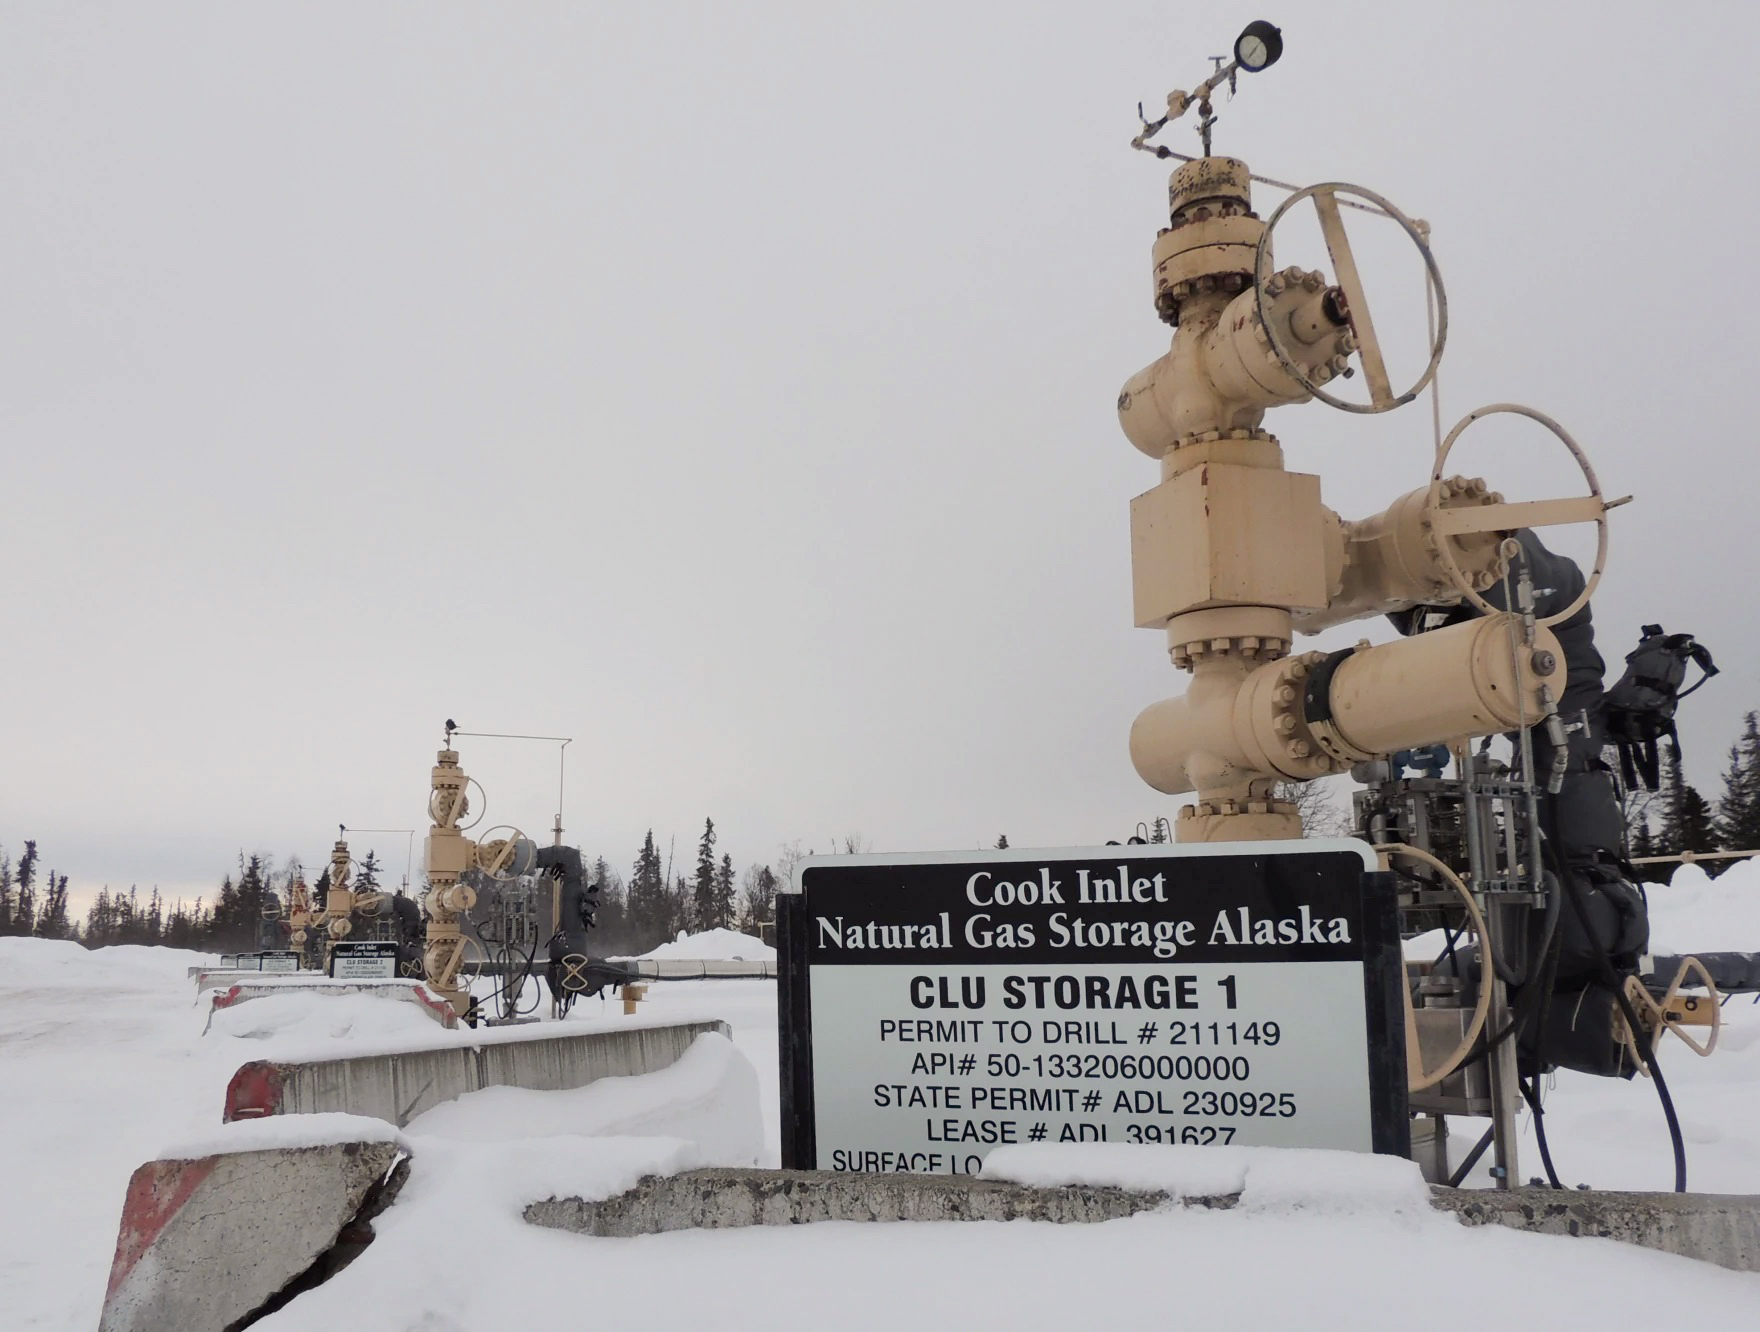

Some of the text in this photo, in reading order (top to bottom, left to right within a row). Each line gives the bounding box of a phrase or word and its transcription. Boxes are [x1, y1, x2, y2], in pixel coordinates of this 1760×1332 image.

[966, 865, 1169, 907] Cook Inlet
[815, 906, 1353, 959] Natural Gas Storage Alaska
[909, 974, 1237, 1010] CLU STORAGE 1
[880, 1019, 1281, 1047] PERMIT TO DRILL # 211149
[910, 1052, 1250, 1082] API# 50-133206000000
[873, 1083, 1297, 1118] STATE PERMIT# ADL 230925
[926, 1118, 1018, 1145] LEASE
[1027, 1121, 1049, 1143] #
[1126, 1123, 1237, 1146] 391627
[831, 1149, 943, 1173] SURFACE
